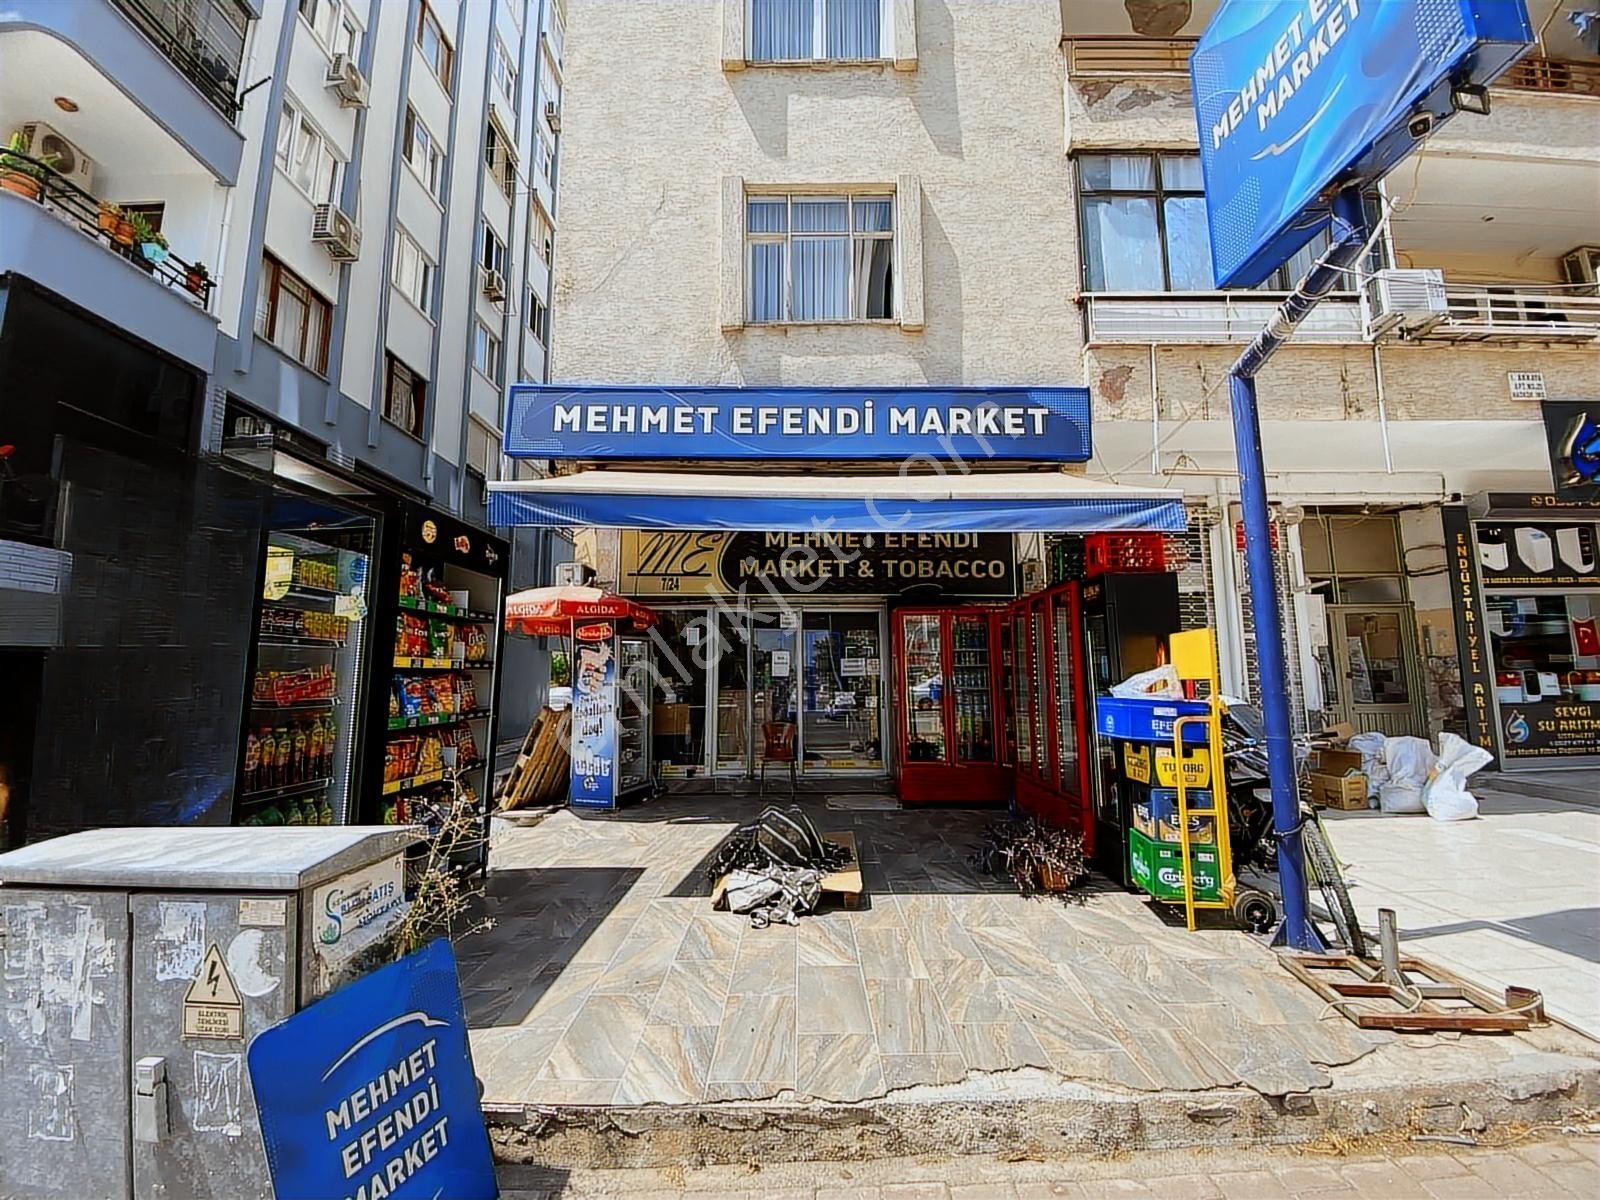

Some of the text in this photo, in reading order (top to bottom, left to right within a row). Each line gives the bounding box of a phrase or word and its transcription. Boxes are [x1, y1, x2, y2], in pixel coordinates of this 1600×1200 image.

[1257, 0, 1360, 132] MARKET
[1212, 11, 1303, 150] MEHMET
[553, 400, 1049, 435] MEHMET EFENDİ MARKET
[739, 558, 1006, 579] MARKET & TOBACCO
[660, 576, 680, 591] 7/24
[576, 605, 616, 614] ALGIDA
[1151, 719, 1177, 730] EFE
[1162, 762, 1205, 773] TUORG
[1170, 814, 1201, 827] ES
[1158, 867, 1215, 890] Carlerg
[326, 1039, 436, 1141] MEHMET
[341, 1076, 439, 1179] EFENDİ
